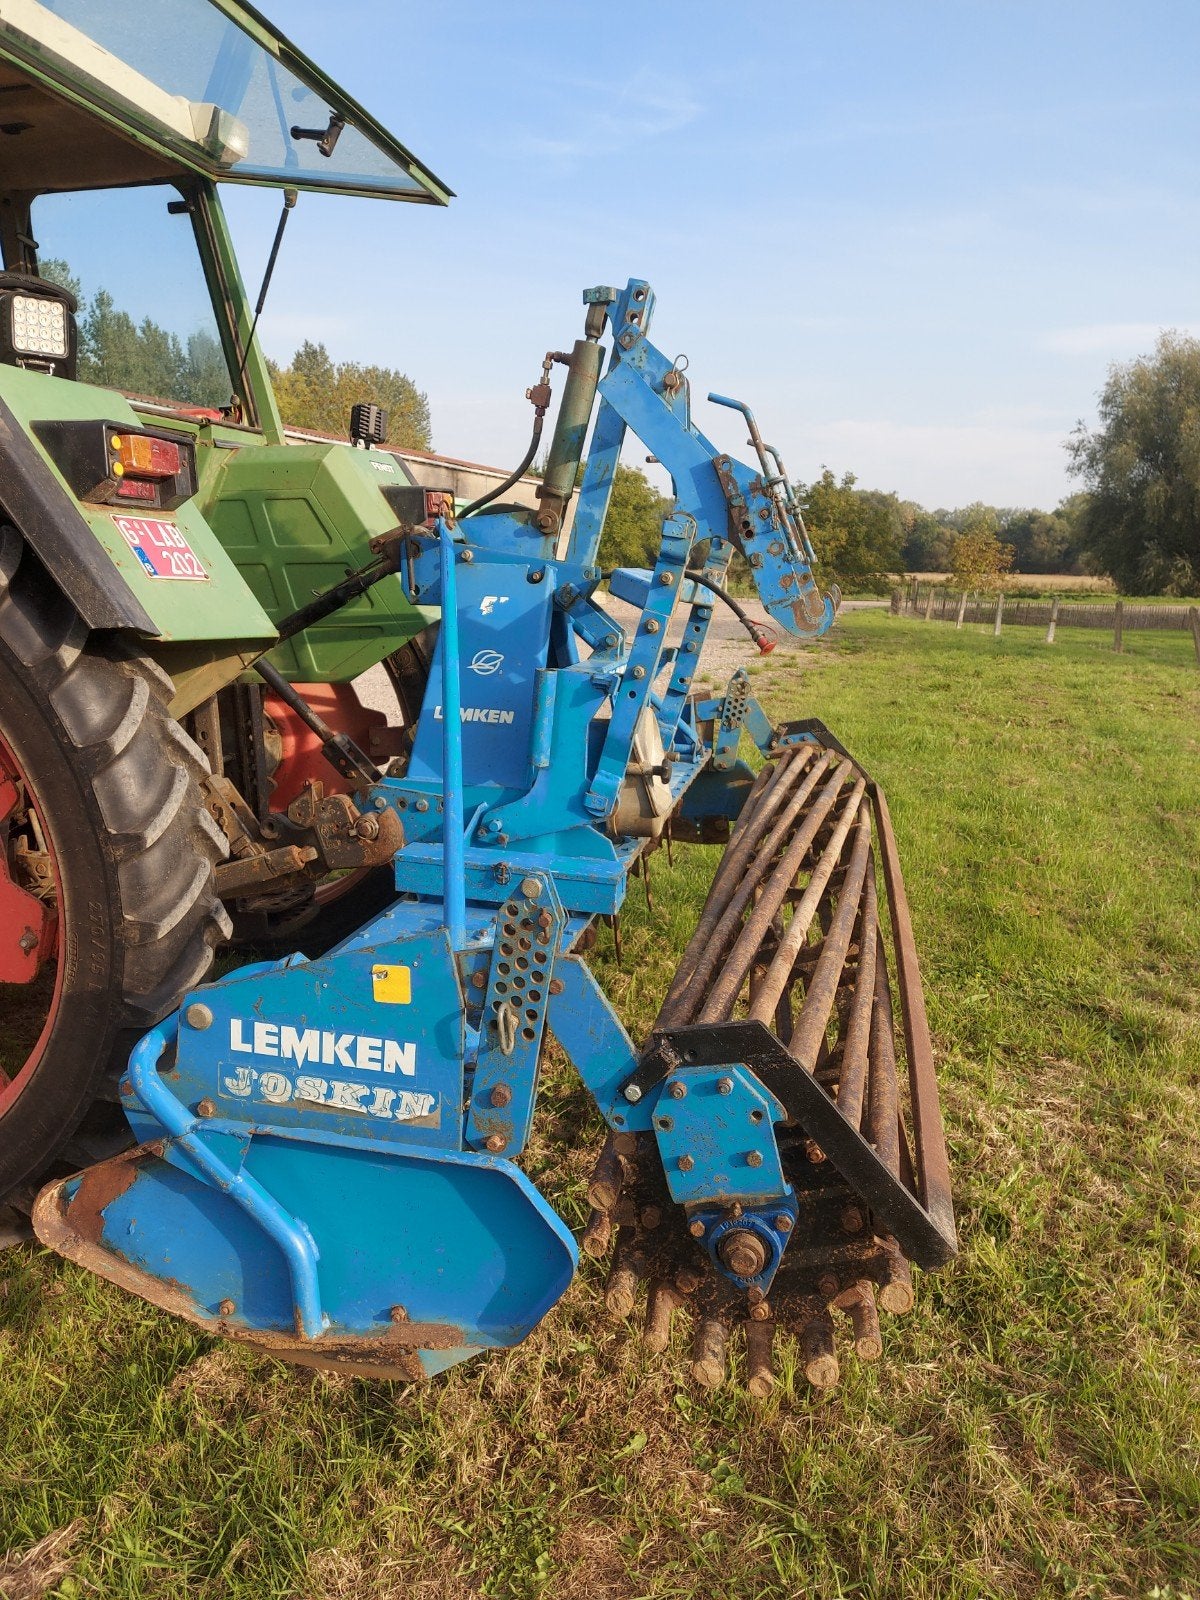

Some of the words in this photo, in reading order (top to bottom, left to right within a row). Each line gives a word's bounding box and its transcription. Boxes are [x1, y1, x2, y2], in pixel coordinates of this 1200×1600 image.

[161, 550, 205, 576] 202
[433, 705, 515, 724] LMKEN
[230, 1018, 416, 1076] LEMKEN
[224, 1066, 436, 1120] JOSKIN
